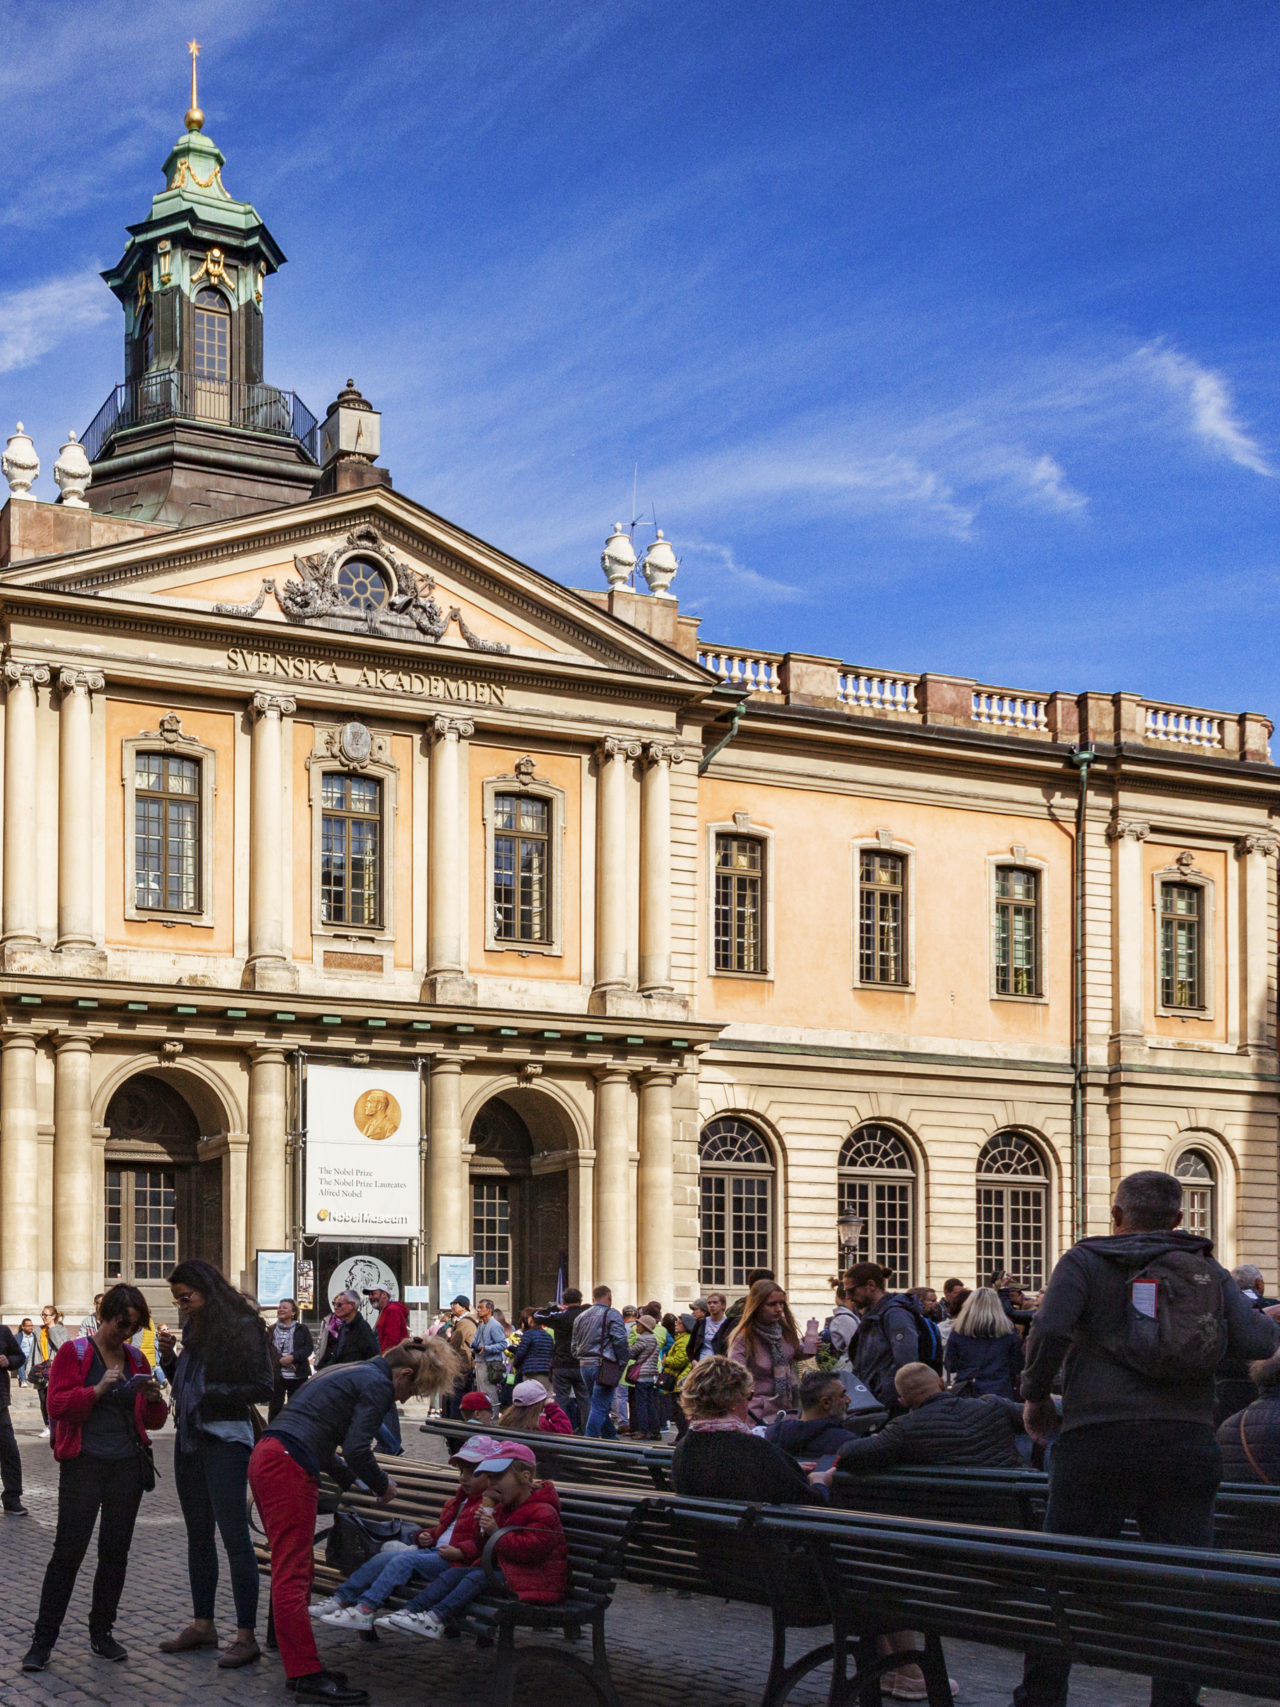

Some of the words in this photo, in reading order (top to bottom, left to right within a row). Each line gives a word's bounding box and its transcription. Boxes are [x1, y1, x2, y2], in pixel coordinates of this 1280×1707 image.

[227, 647, 340, 684] SVENSKA
[355, 666, 507, 705] AKADEMIEN
[319, 1166, 332, 1175] The
[334, 1167, 354, 1176] Nobel
[355, 1168, 373, 1177] Prize
[319, 1177, 332, 1186] The
[334, 1178, 354, 1187] Nobel
[355, 1179, 373, 1188] Prize
[374, 1180, 407, 1189] Laureates
[318, 1188, 340, 1197] Alfred
[342, 1189, 362, 1198] Nobel
